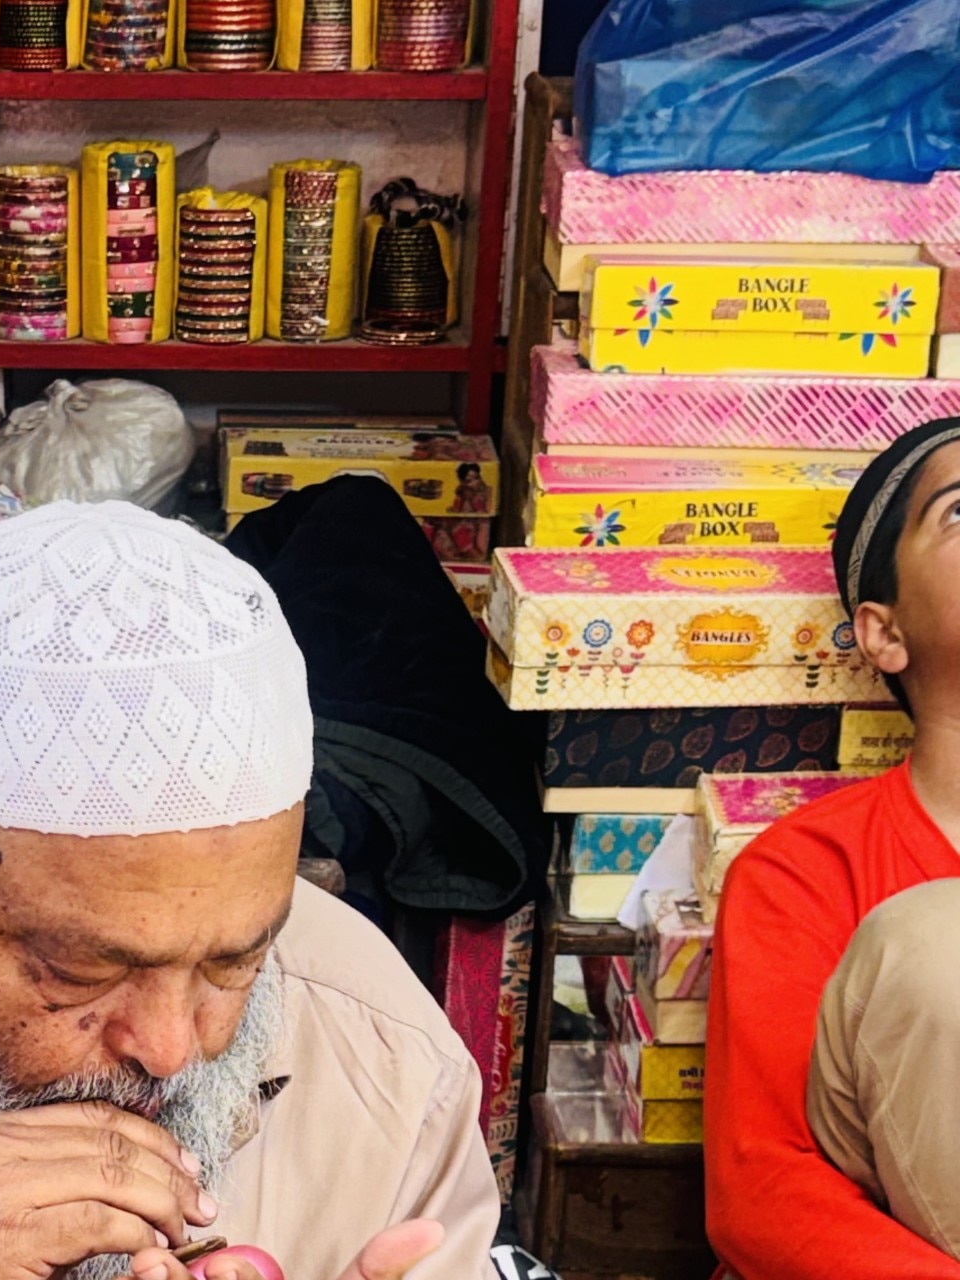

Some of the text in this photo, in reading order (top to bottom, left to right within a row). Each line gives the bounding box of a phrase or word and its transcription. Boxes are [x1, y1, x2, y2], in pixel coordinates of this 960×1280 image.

[738, 278, 809, 293] BANGLE
[752, 297, 791, 312] BOX
[686, 502, 758, 518] BANGLE
[700, 521, 740, 537] BOX
[691, 631, 751, 643] BANGLES
